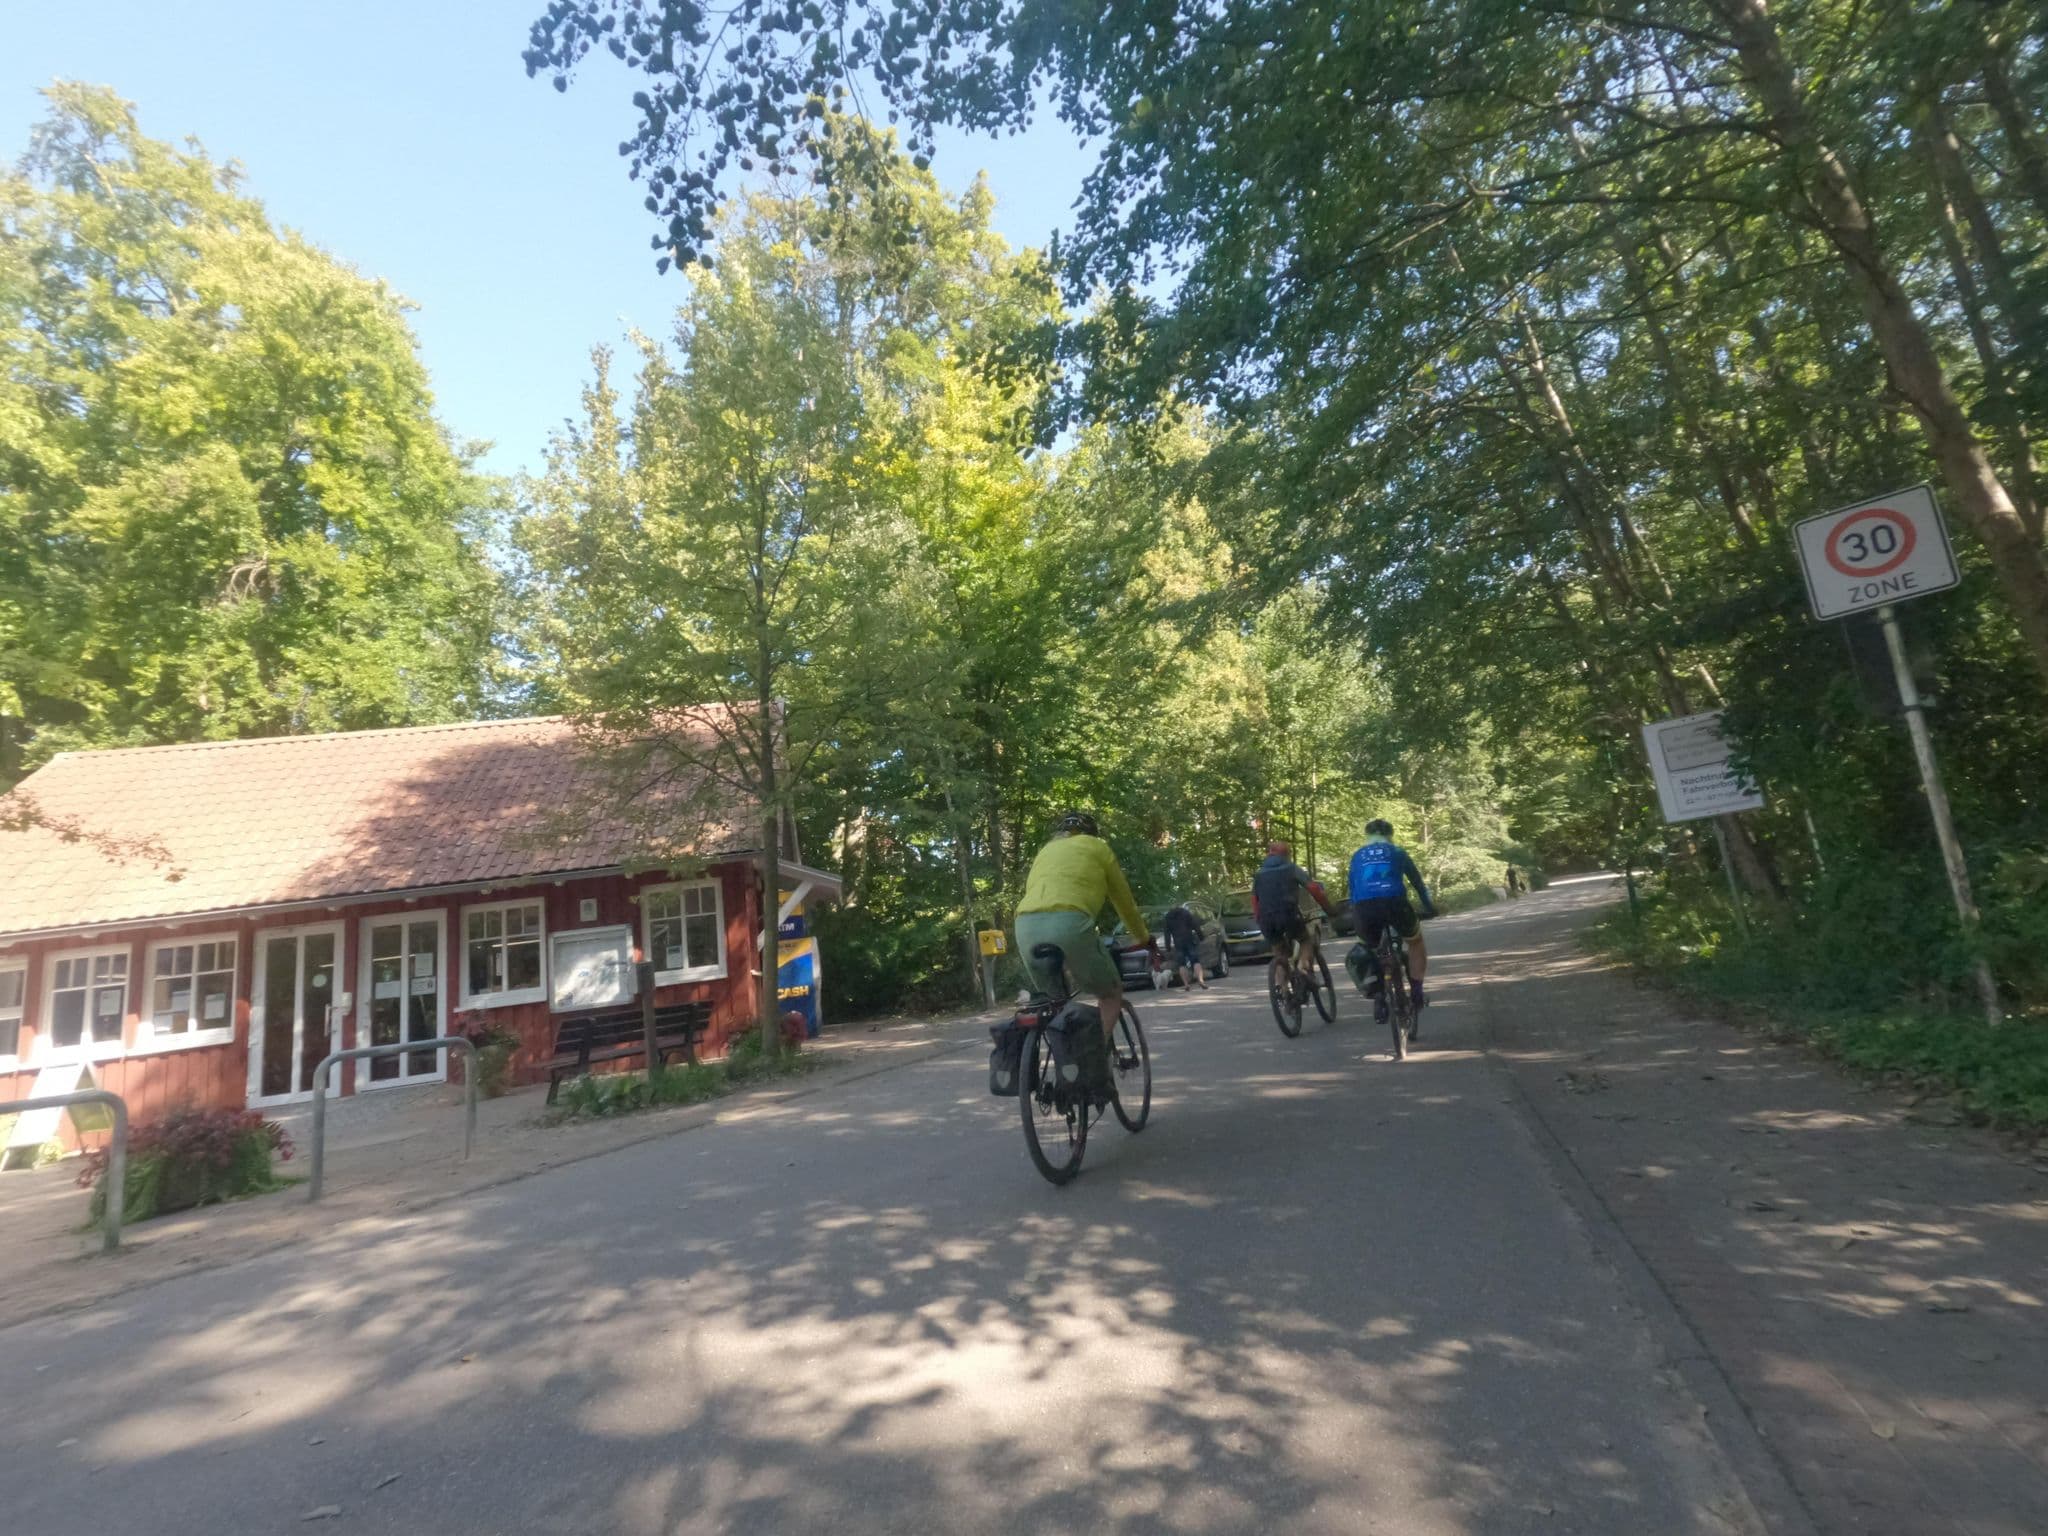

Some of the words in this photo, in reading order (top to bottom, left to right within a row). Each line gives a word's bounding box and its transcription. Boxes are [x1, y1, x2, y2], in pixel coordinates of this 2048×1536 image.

[1842, 524, 1897, 562] 30
[1848, 571, 1919, 603] ZONE
[777, 985, 809, 1000] CASH
